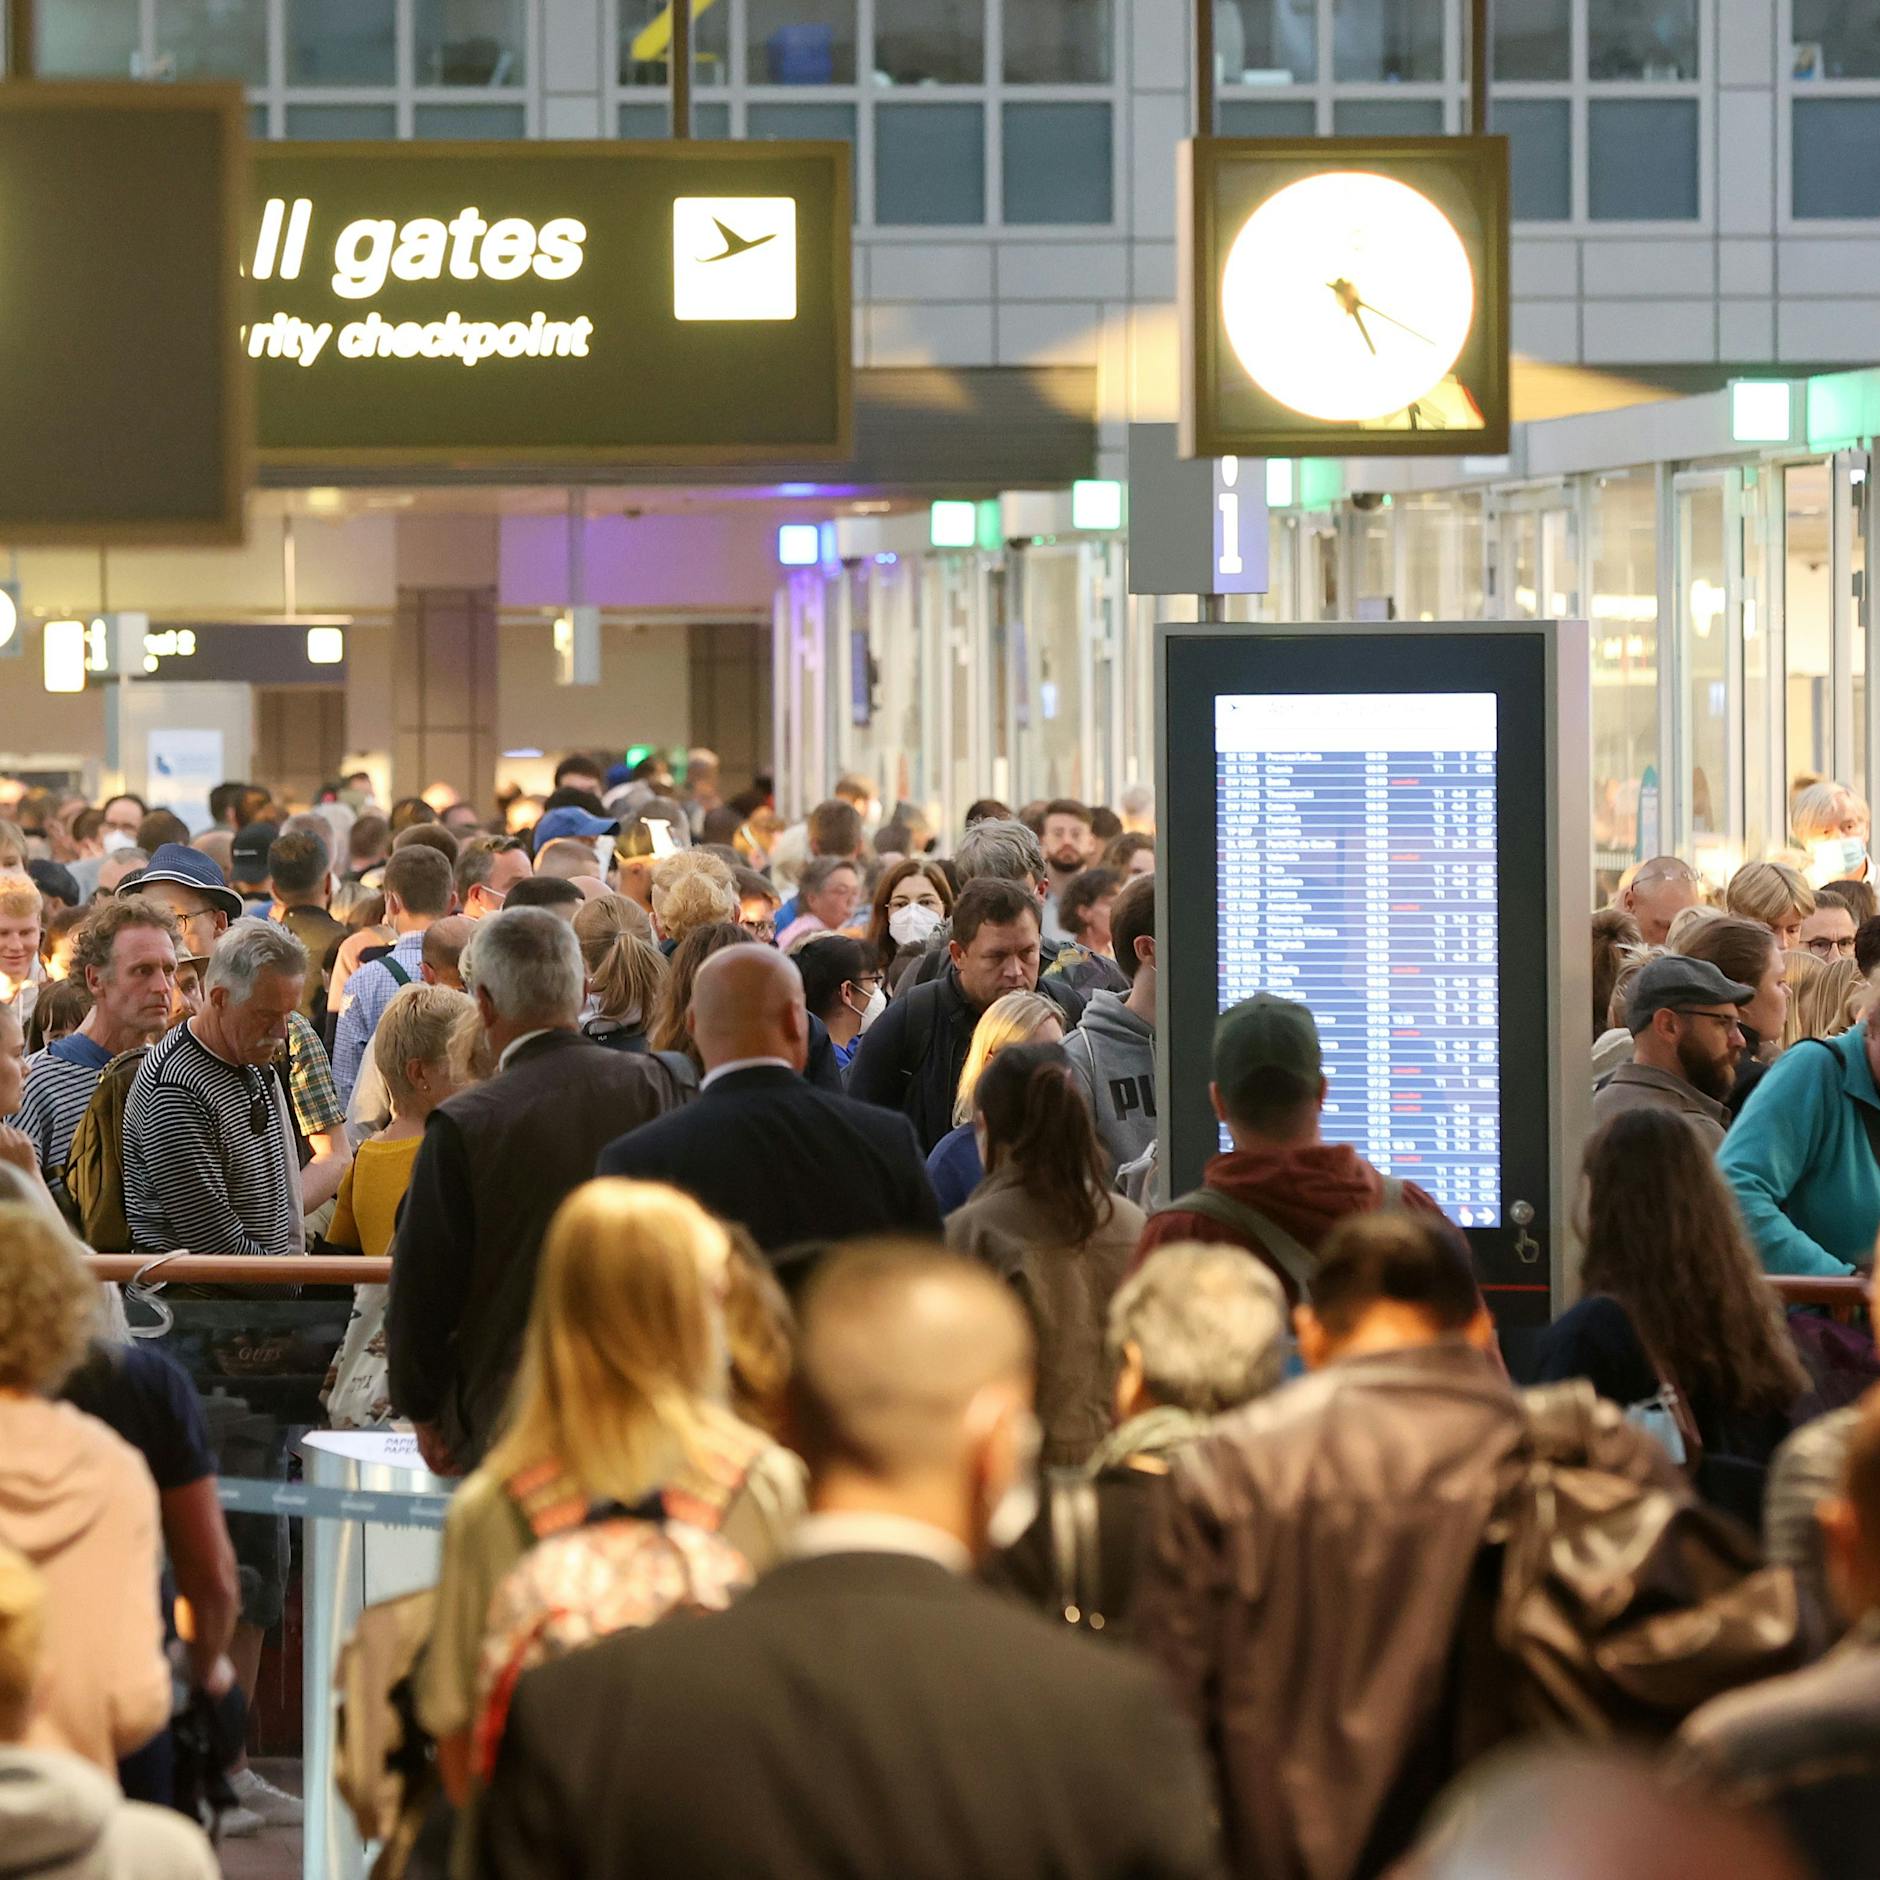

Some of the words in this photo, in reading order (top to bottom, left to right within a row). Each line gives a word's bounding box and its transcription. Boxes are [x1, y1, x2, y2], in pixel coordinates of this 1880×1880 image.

[240, 198, 313, 280] ll
[331, 206, 587, 299] gates
[240, 311, 333, 367] rity
[337, 311, 594, 367] checkpoint
